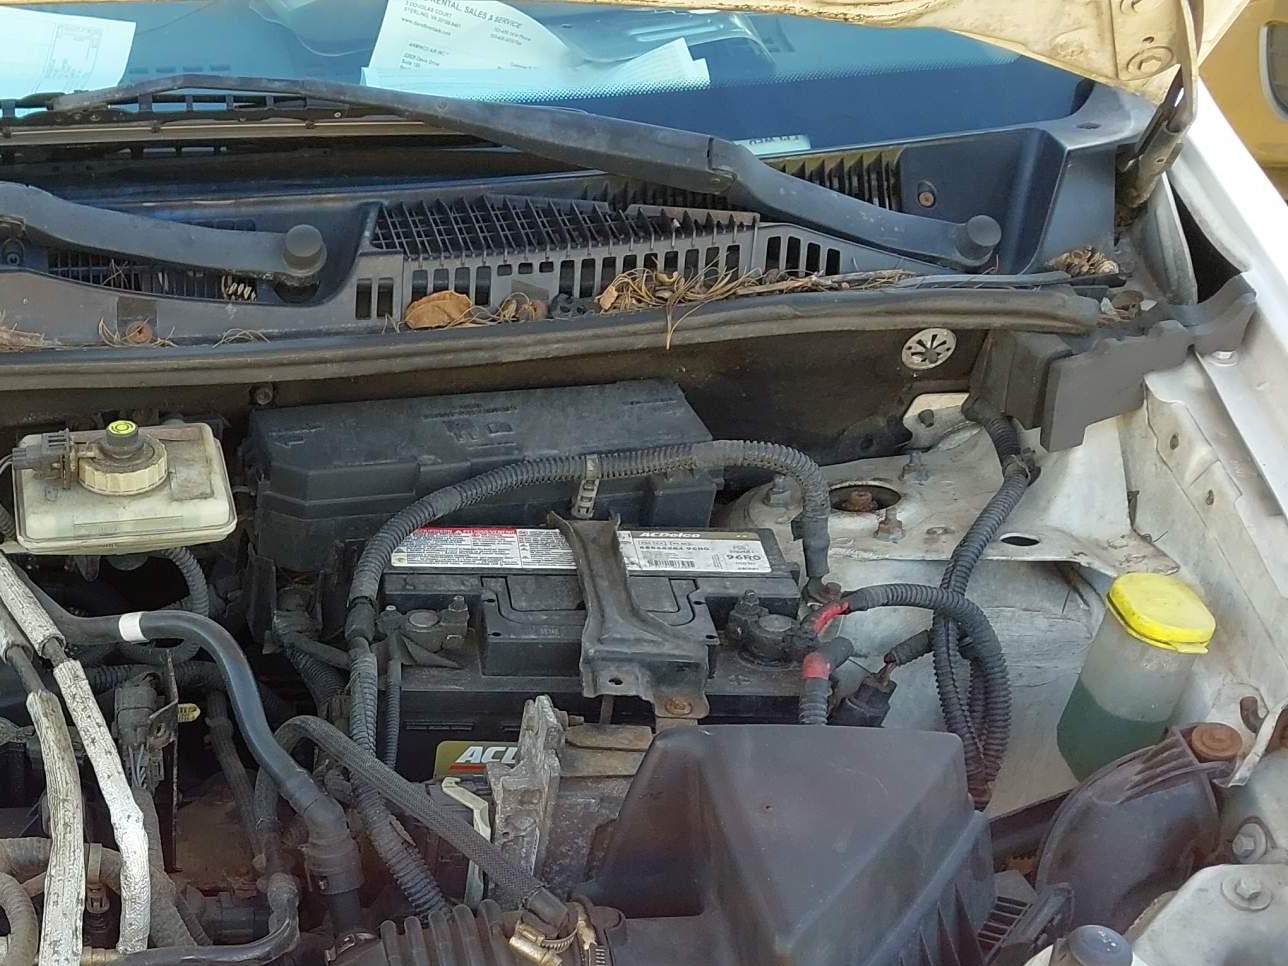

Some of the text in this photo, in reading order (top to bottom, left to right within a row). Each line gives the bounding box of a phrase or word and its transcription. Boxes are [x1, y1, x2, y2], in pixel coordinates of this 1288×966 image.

[464, 6, 488, 20] SALES
[494, 15, 523, 29] SERVICE
[639, 531, 702, 539] ACDelco
